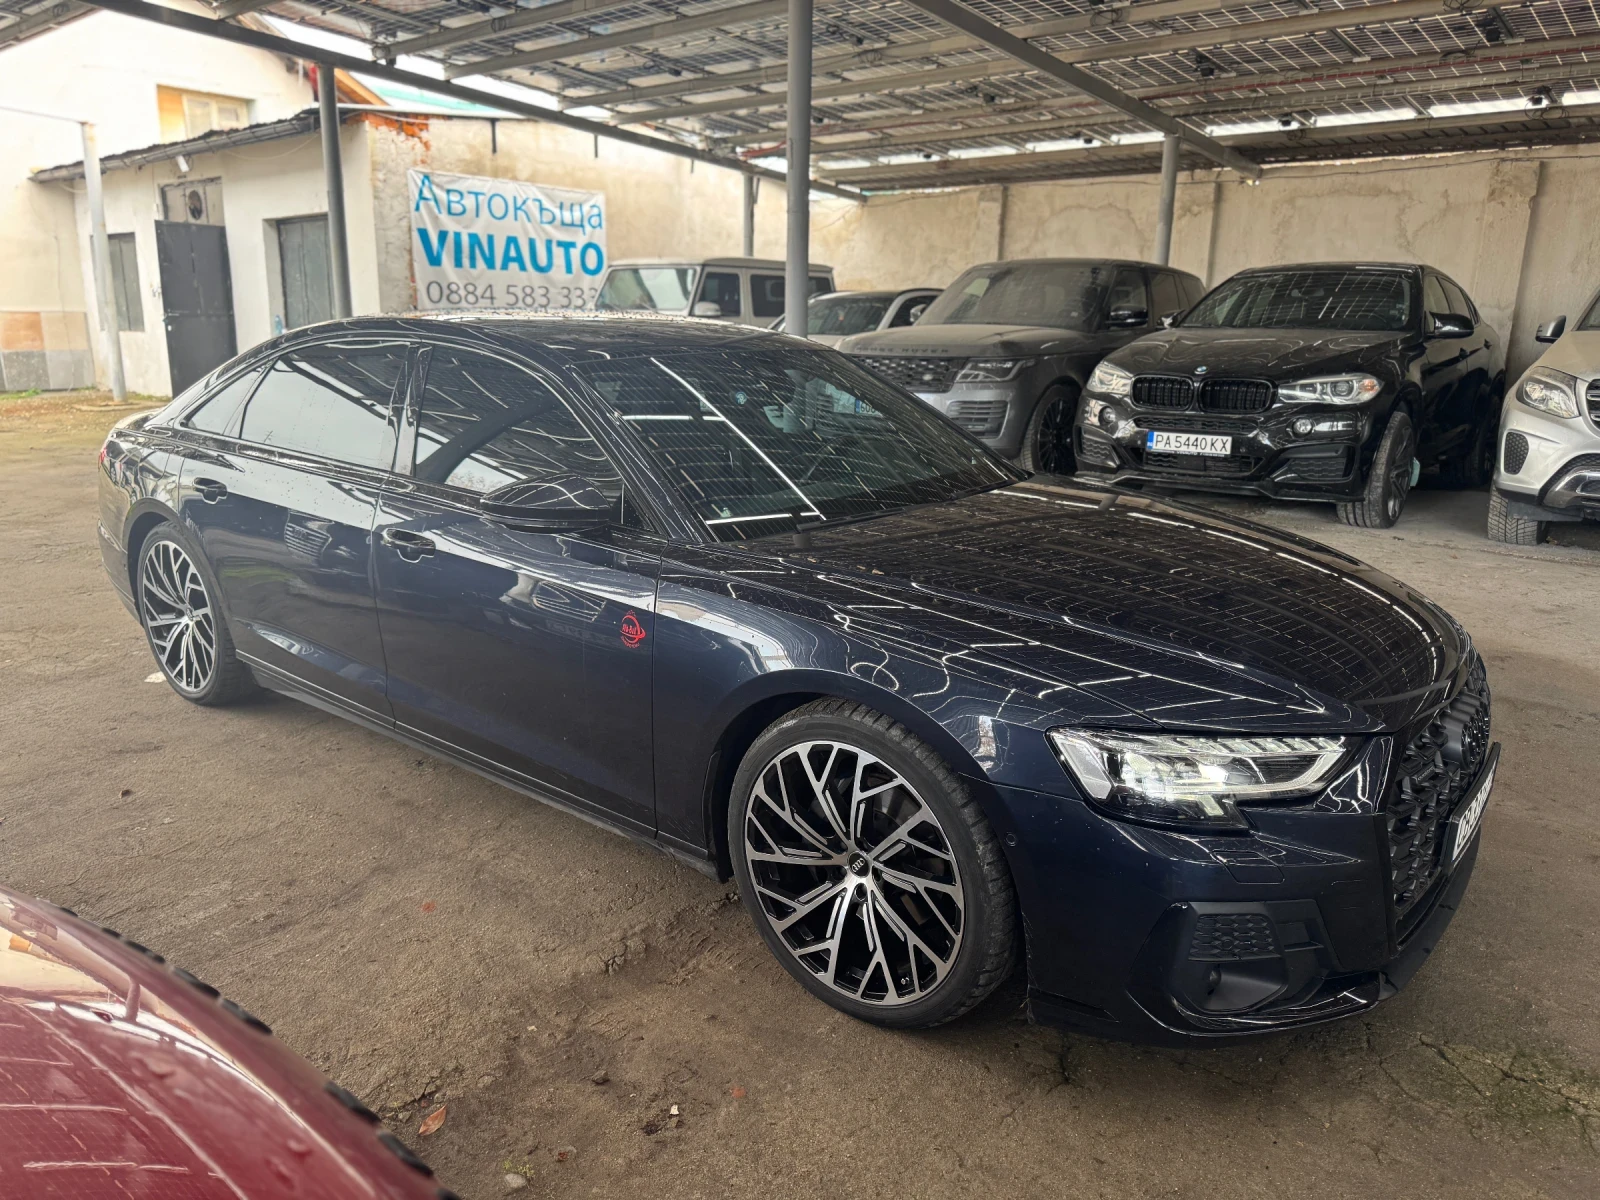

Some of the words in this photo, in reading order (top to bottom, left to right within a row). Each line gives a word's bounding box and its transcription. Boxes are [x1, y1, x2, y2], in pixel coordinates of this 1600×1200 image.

[414, 174, 603, 236] Автокъща
[416, 227, 605, 276] VINAUTO
[426, 280, 497, 306] 0884
[505, 284, 551, 309] 583
